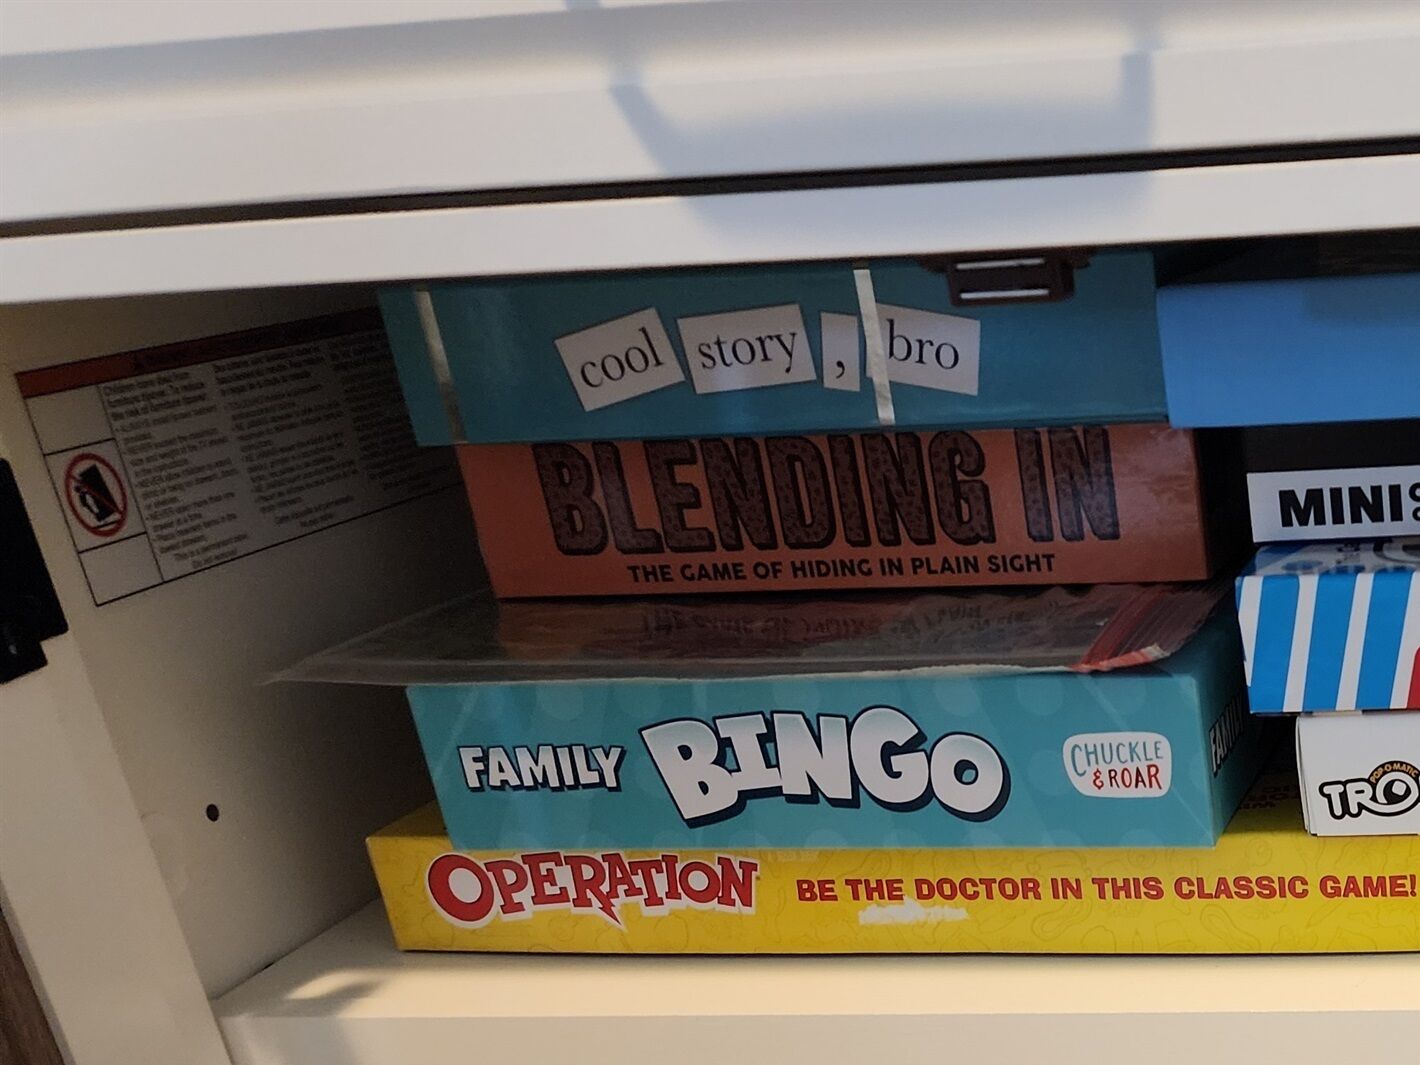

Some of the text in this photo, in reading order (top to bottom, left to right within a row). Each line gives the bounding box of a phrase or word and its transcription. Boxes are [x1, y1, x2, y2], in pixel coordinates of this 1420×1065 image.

[580, 327, 665, 391] cool
[696, 326, 799, 371] story
[886, 316, 961, 372] bro
[532, 426, 1121, 556] BLENDING IN
[1278, 484, 1402, 528] MINI
[627, 552, 1057, 585] THE GAME OF HIDING IN PLAIN SIGHT
[459, 743, 627, 794] FAMILY
[639, 704, 1010, 828] BINGO
[1070, 740, 1164, 777] CHUCKLE
[1108, 763, 1163, 791] ROAR
[427, 851, 759, 925] OPERATION
[797, 874, 1418, 902] BE THE DOCTOR IN THIS CLASSIC GAME!
